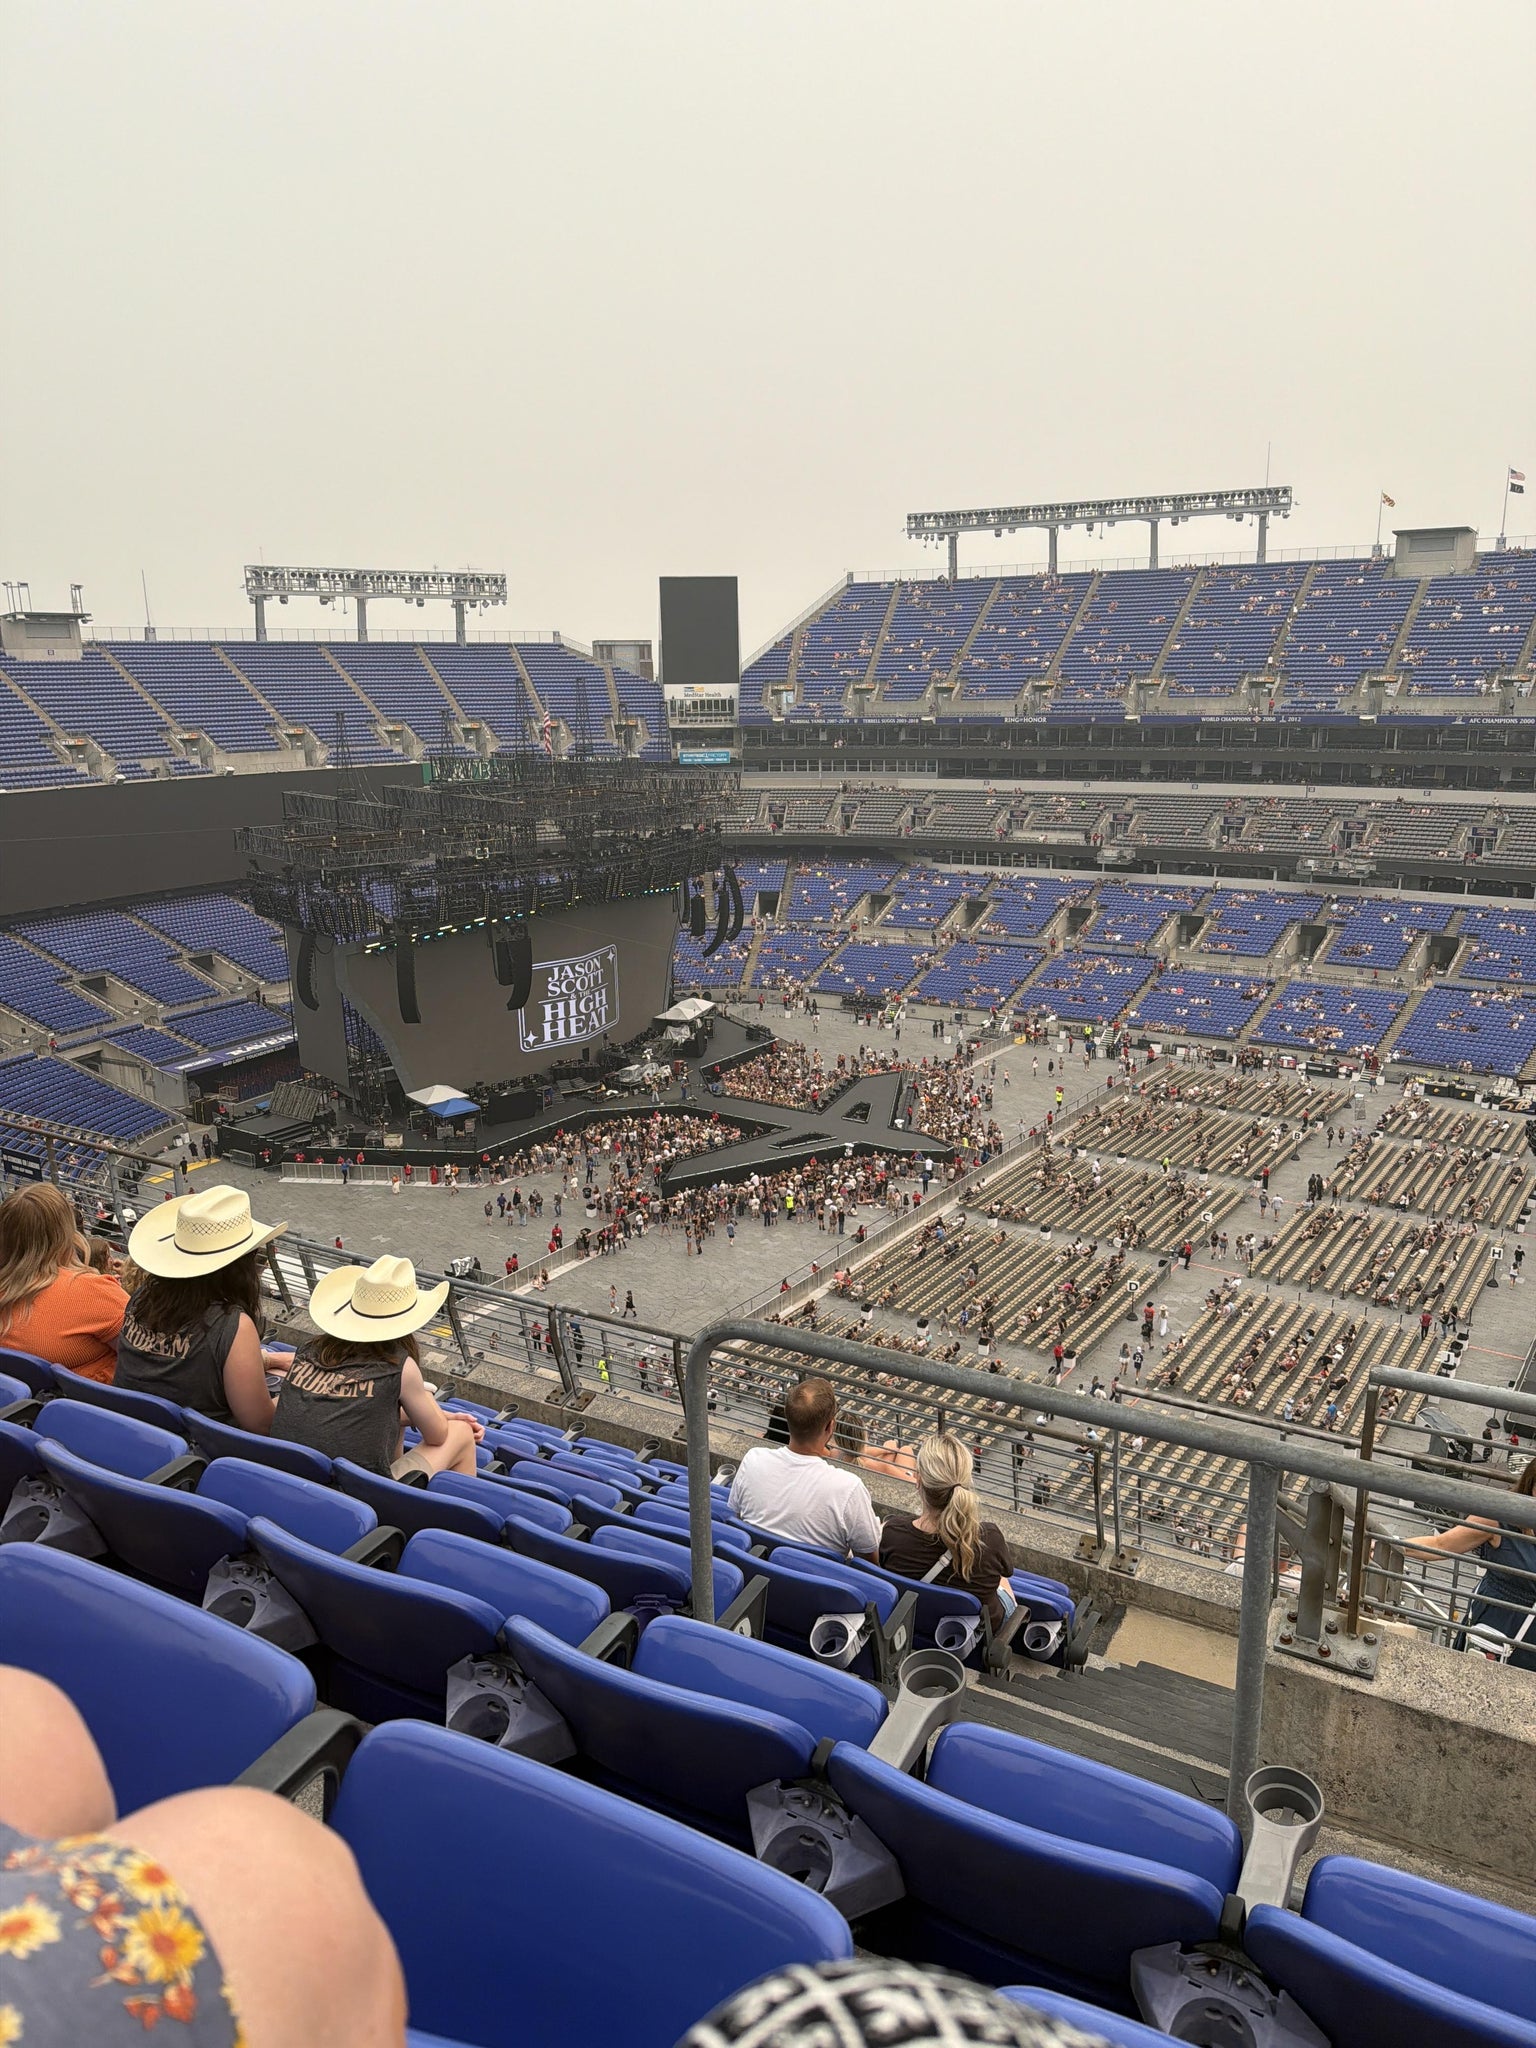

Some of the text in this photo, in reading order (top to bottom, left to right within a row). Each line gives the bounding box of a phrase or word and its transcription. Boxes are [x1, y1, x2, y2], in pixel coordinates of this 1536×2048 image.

[547, 956, 601, 982] JASON
[547, 968, 604, 997] SCOTT
[579, 990, 590, 998] THE
[542, 988, 607, 1022] HIGH
[542, 1005, 608, 1042] HEAT
[1203, 1213, 1211, 1222] C
[1491, 1248, 1502, 1259] H
[1129, 1282, 1139, 1291] D
[1443, 1353, 1451, 1363] J
